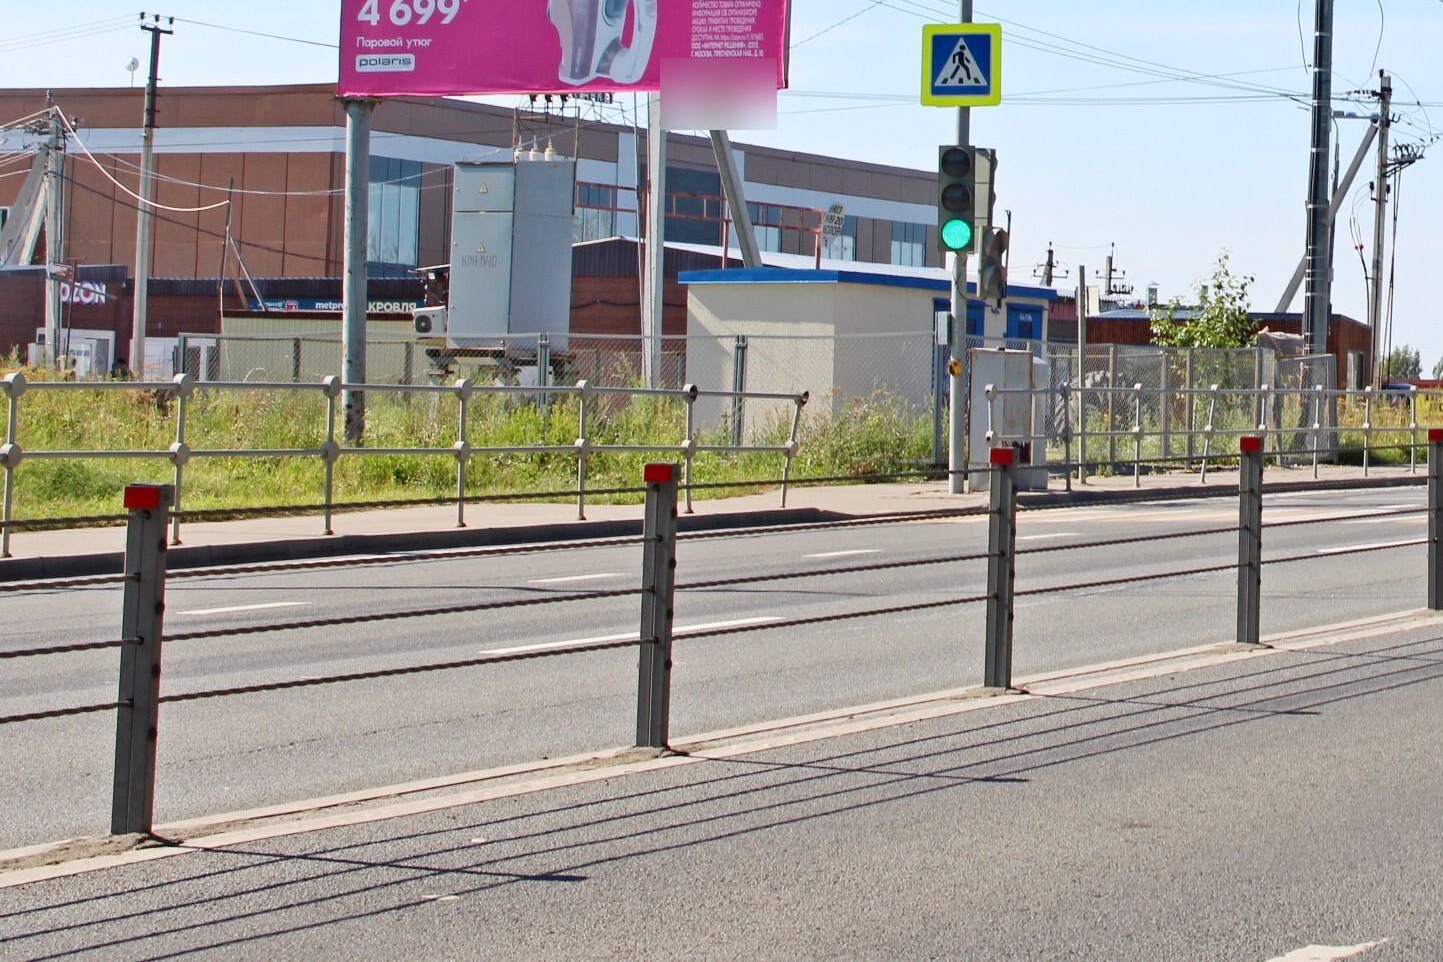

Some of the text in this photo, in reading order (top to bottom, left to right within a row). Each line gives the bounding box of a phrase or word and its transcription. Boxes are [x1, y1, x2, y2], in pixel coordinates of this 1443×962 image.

[356, 36, 432, 49] Паровой утюг
[359, 57, 412, 68] polaris
[61, 281, 106, 304] OZON
[368, 301, 417, 313] КРОВЛЯ
